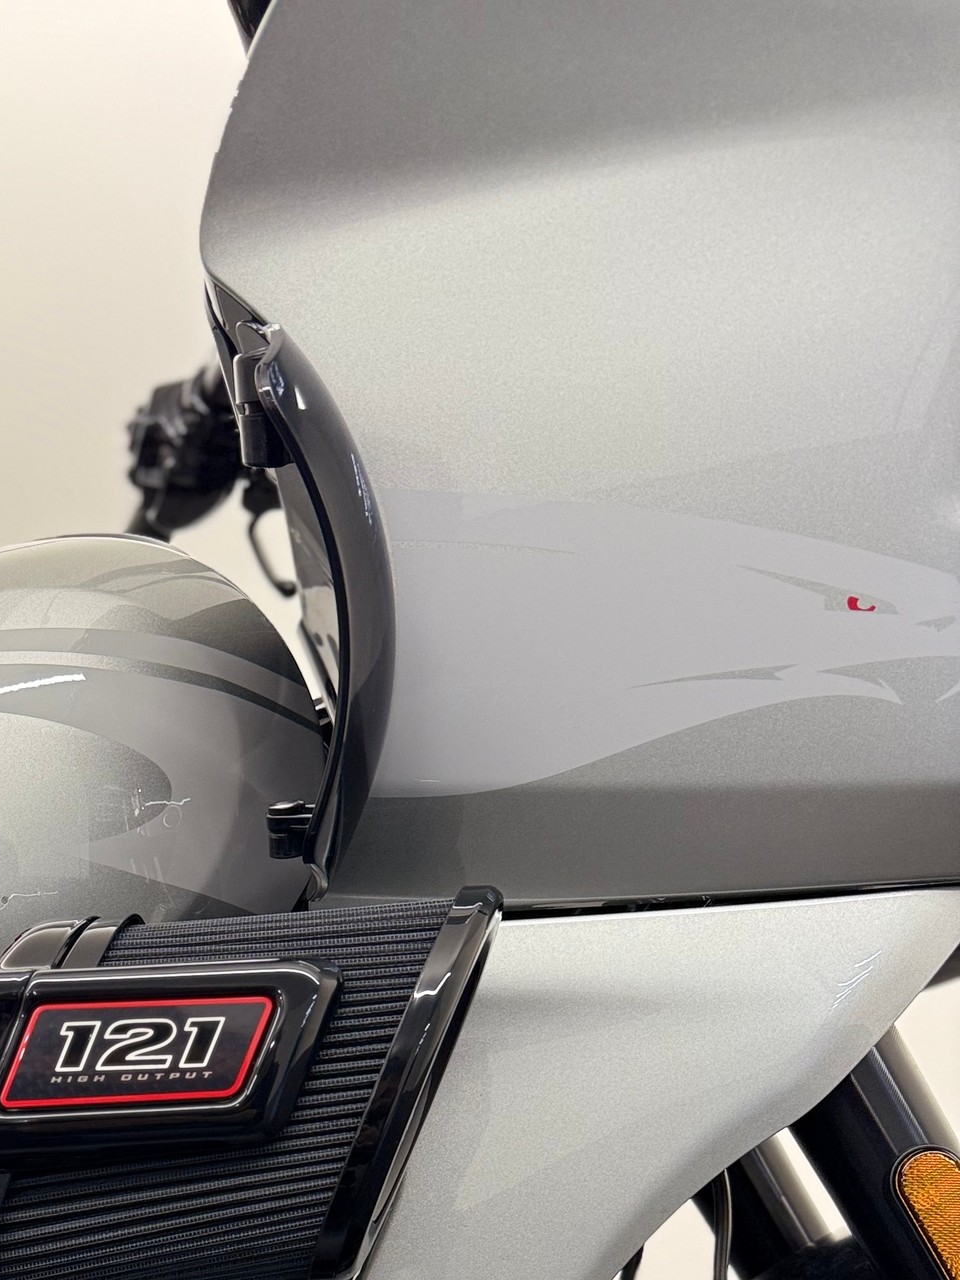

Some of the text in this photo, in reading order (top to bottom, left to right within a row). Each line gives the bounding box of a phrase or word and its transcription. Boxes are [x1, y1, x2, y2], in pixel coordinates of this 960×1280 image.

[54, 1016, 226, 1073] 121
[50, 1071, 214, 1084] HIGH OUTPUT
